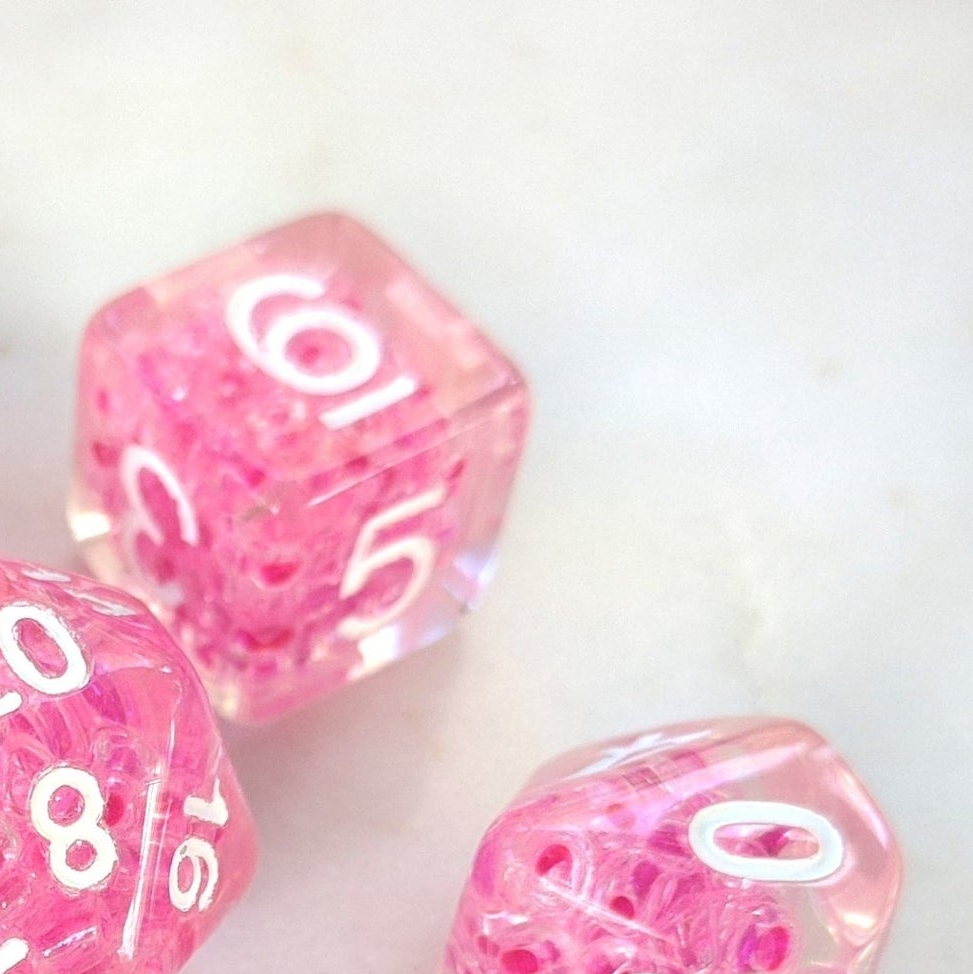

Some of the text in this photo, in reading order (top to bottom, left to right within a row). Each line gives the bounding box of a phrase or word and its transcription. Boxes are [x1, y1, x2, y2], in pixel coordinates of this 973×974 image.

[229, 274, 418, 432] 6
[339, 487, 446, 638] 5
[29, 764, 119, 892] 8
[168, 778, 231, 912] 16
[688, 800, 844, 883] 0
